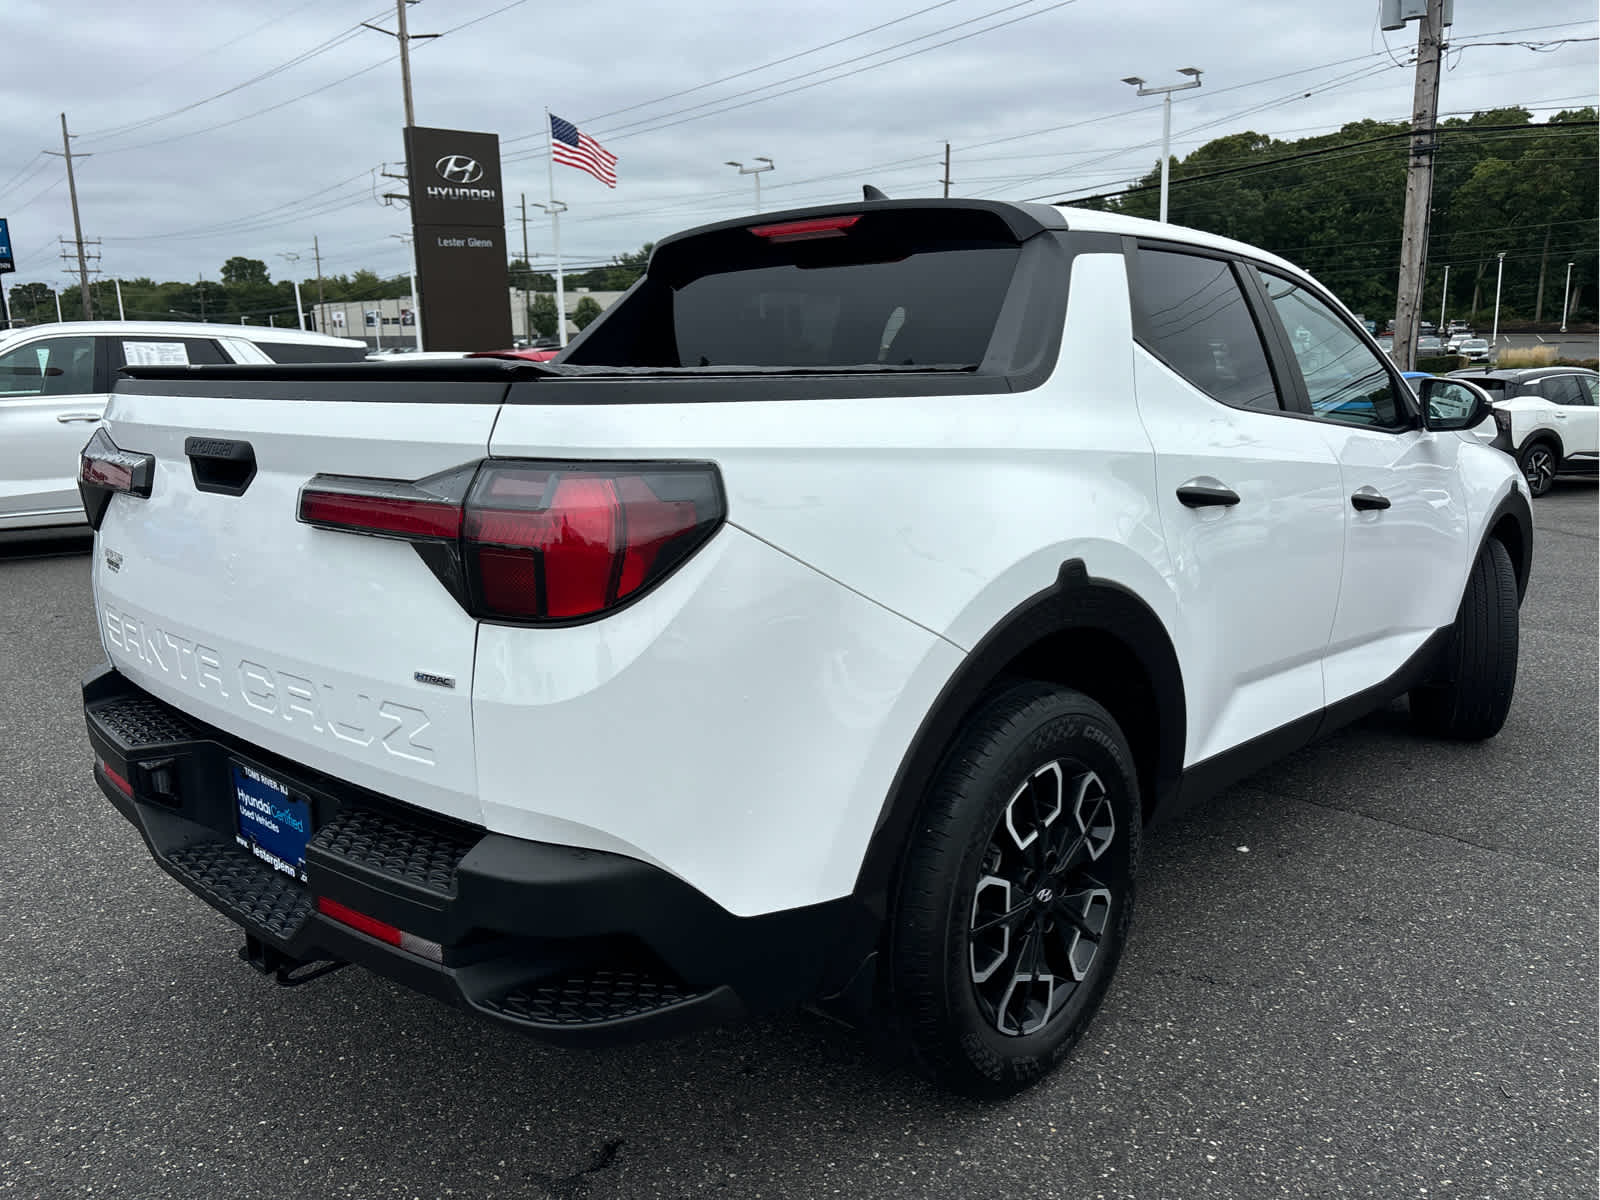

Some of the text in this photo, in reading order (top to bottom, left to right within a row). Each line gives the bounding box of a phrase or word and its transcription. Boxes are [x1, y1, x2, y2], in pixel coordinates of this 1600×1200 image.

[427, 185, 495, 200] HYUNDAI
[437, 236, 493, 248] Lester Glenn
[190, 440, 233, 457] HYUNDAI
[104, 606, 436, 766] SANTA CRUZ
[415, 671, 454, 688] HTRAC
[244, 766, 261, 782] TOMS
[280, 784, 289, 796] NJ
[240, 804, 280, 833] Used Vehicles
